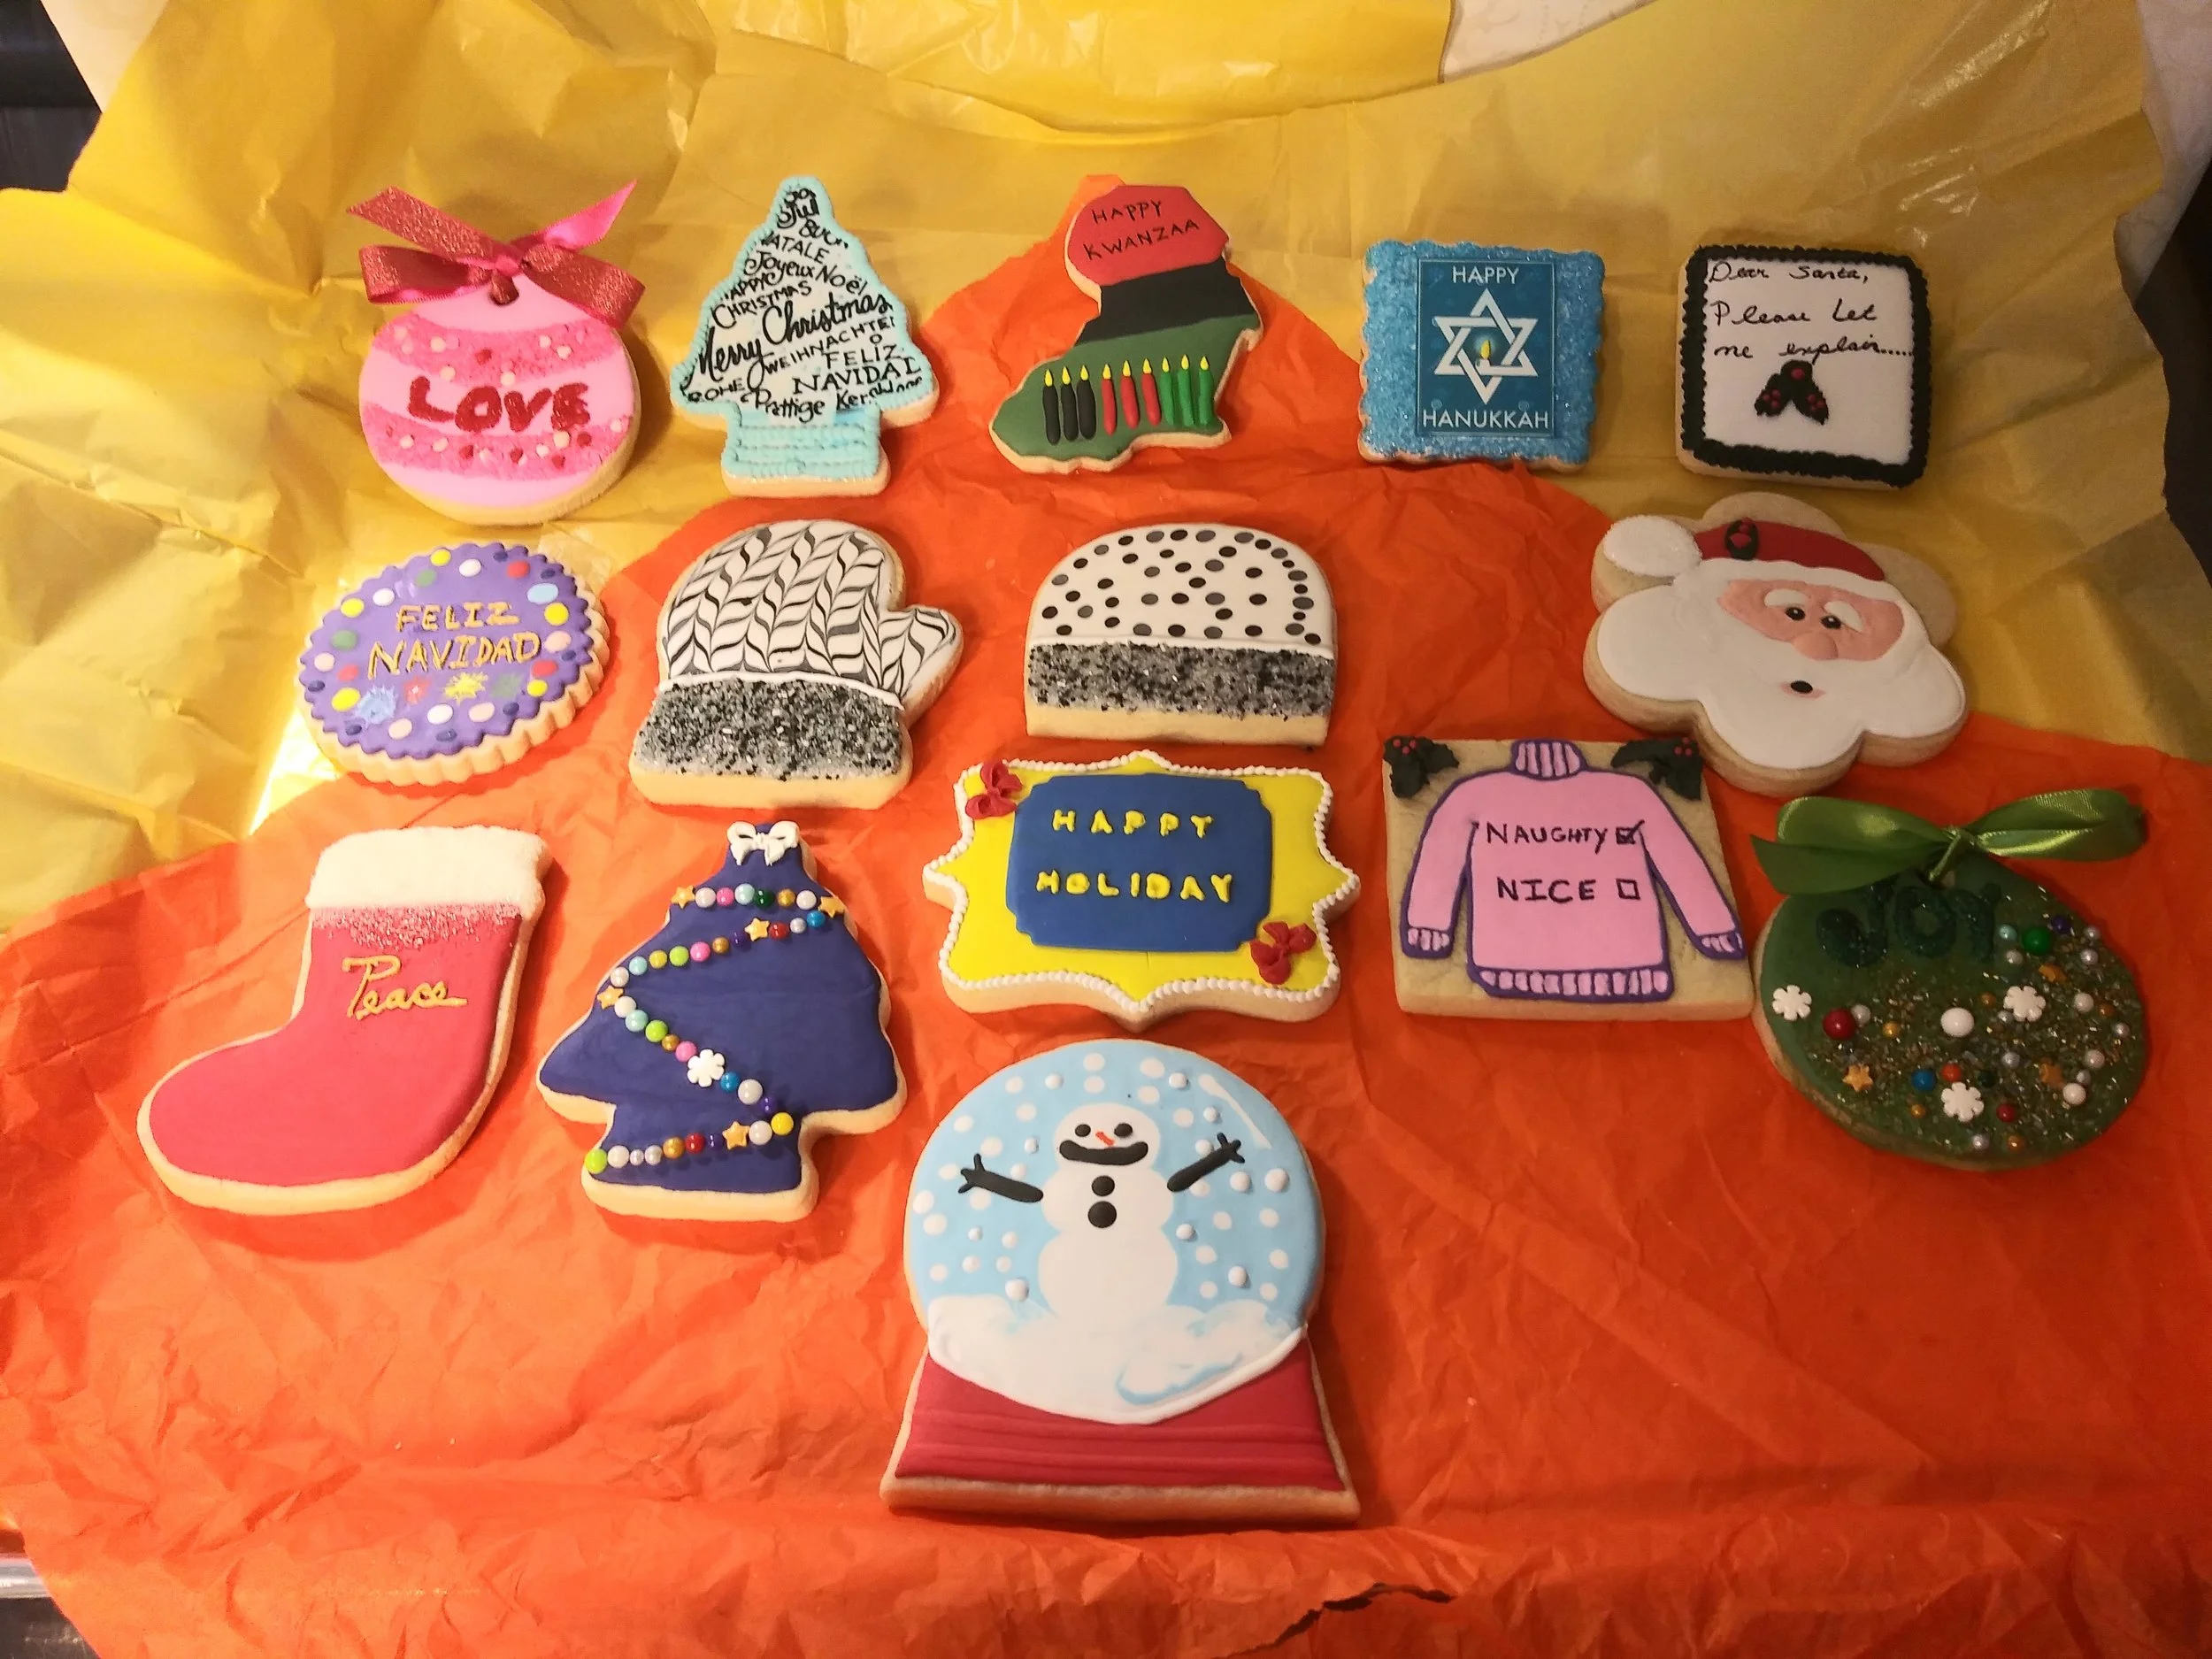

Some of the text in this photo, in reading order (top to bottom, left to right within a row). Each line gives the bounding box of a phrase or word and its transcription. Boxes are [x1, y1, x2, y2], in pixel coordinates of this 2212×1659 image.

[1091, 200, 1162, 225] HAPPY
[1082, 219, 1200, 261] KWANZAA
[743, 250, 868, 296] Joyeux Noël
[1452, 265, 1519, 284] HAPPY
[1709, 261, 1869, 283] Dear Santa,
[710, 280, 812, 329] CHRISTMAS
[762, 292, 894, 345] Christmas
[1709, 300, 1810, 326] Please
[1714, 344, 1754, 359] me
[408, 375, 591, 433] LOVE
[1423, 409, 1548, 429] HANUKKAH
[396, 601, 520, 633] FELIZ
[367, 631, 541, 680] NAVIDAD
[1052, 809, 1213, 838] HAPPY
[1486, 821, 1608, 855] NAUGHTY
[1036, 870, 1233, 902] HOLIDAY
[1496, 876, 1596, 903] NICE
[1816, 878, 2002, 968] JOY
[342, 954, 468, 1021] Peace
